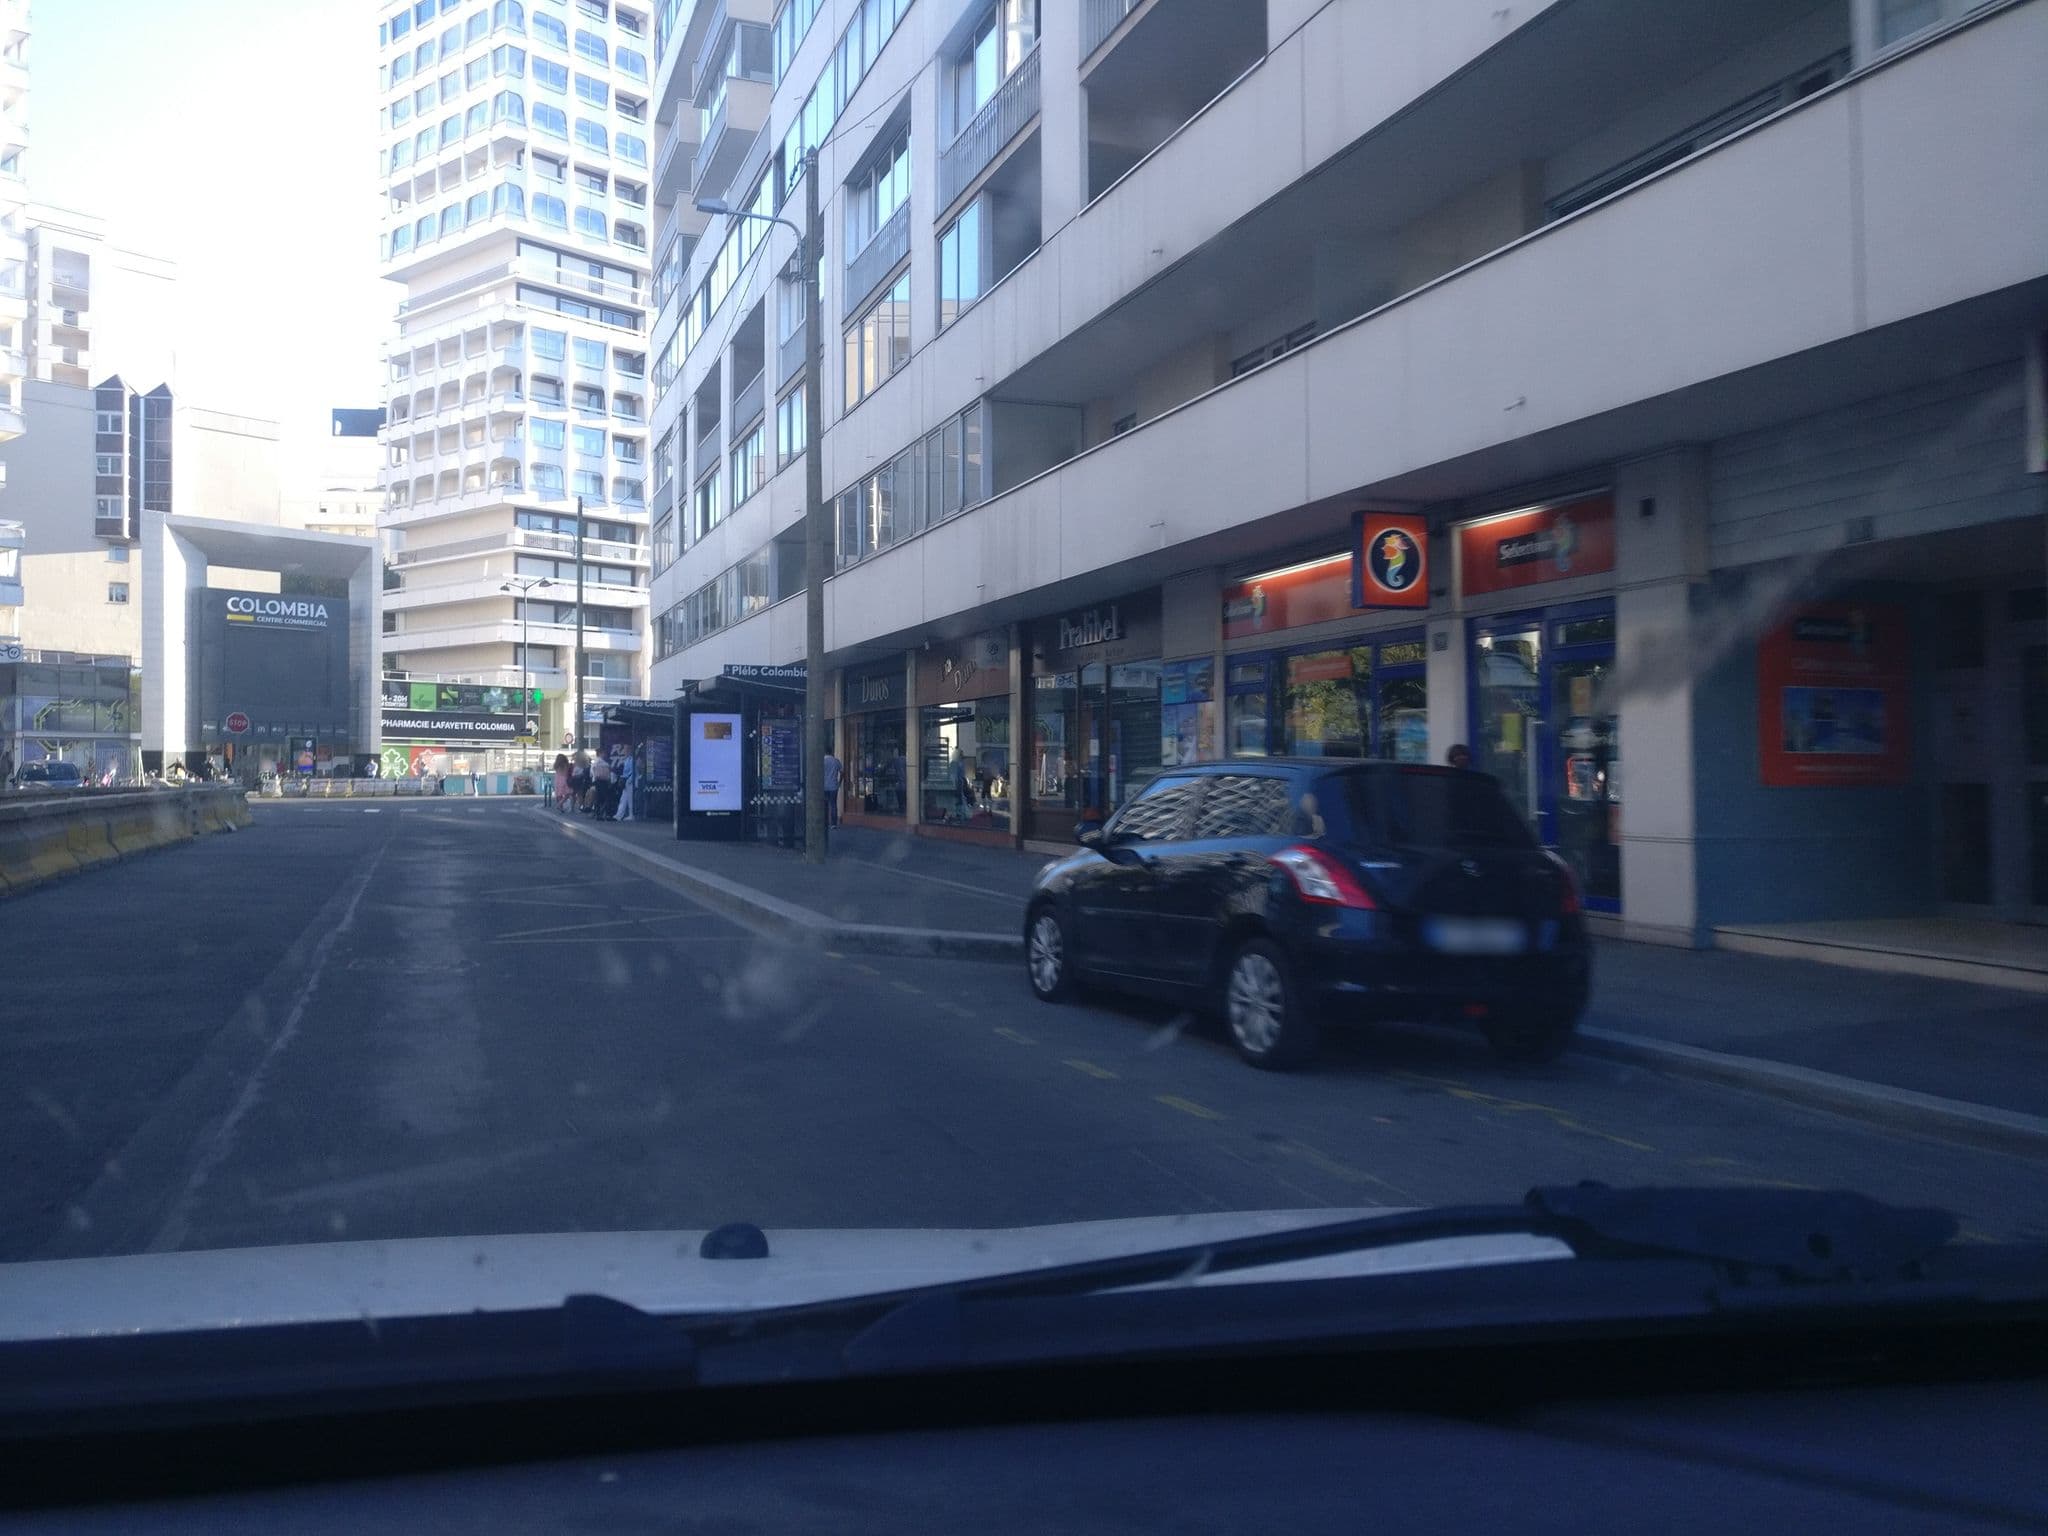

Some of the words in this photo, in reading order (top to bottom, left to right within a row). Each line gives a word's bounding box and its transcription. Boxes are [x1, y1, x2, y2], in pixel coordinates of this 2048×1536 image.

[227, 597, 328, 618] COLOMBIA
[257, 615, 284, 624] CENTRE
[285, 617, 327, 627] COMMERCIAL
[732, 665, 757, 677] Plélo
[229, 718, 247, 728] STOP
[381, 719, 430, 729] PHARMACIE
[431, 721, 474, 730] LAFAYETTE
[475, 723, 516, 732] COLOMBIA
